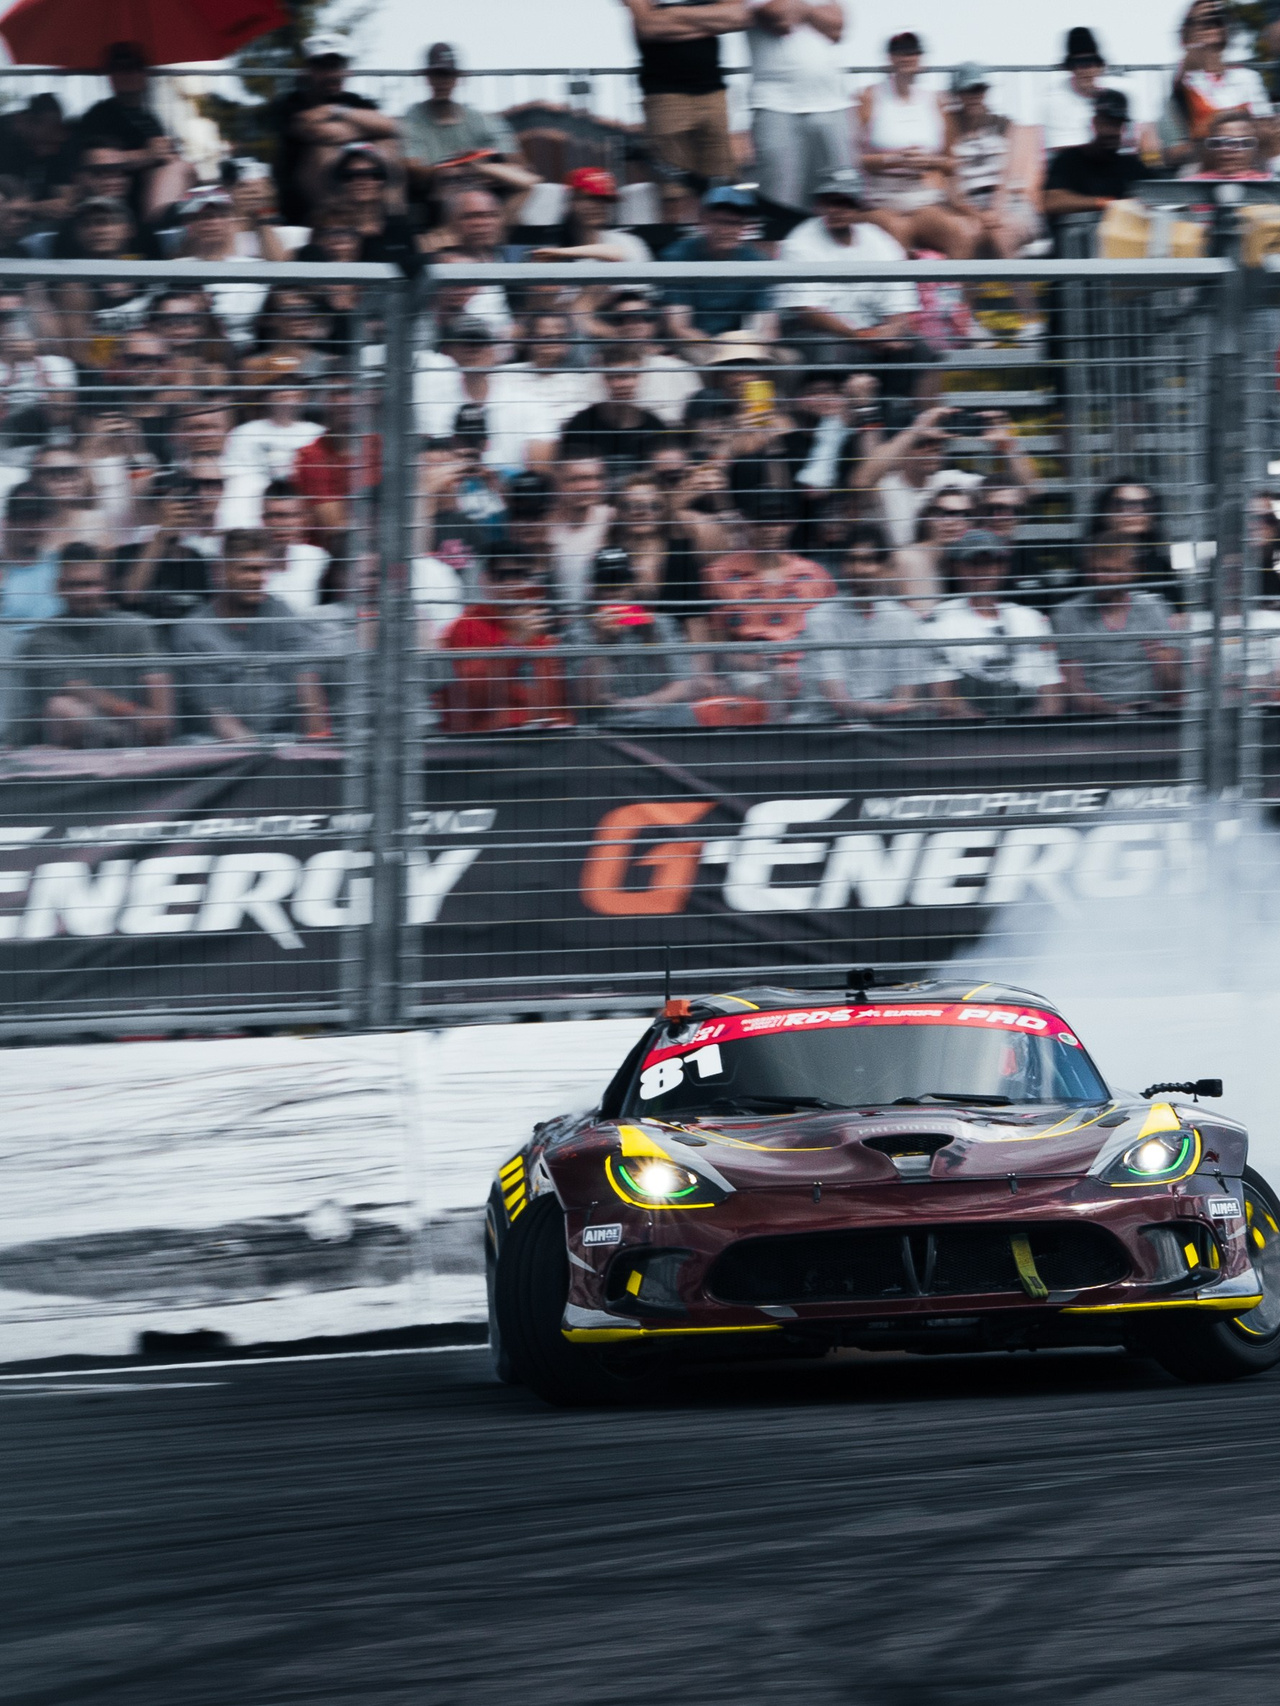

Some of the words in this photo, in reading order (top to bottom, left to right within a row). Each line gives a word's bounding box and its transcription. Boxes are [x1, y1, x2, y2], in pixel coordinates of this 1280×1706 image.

[783, 1009, 855, 1027] RDS
[958, 1008, 1048, 1030] PRO
[639, 1043, 724, 1101] 81
